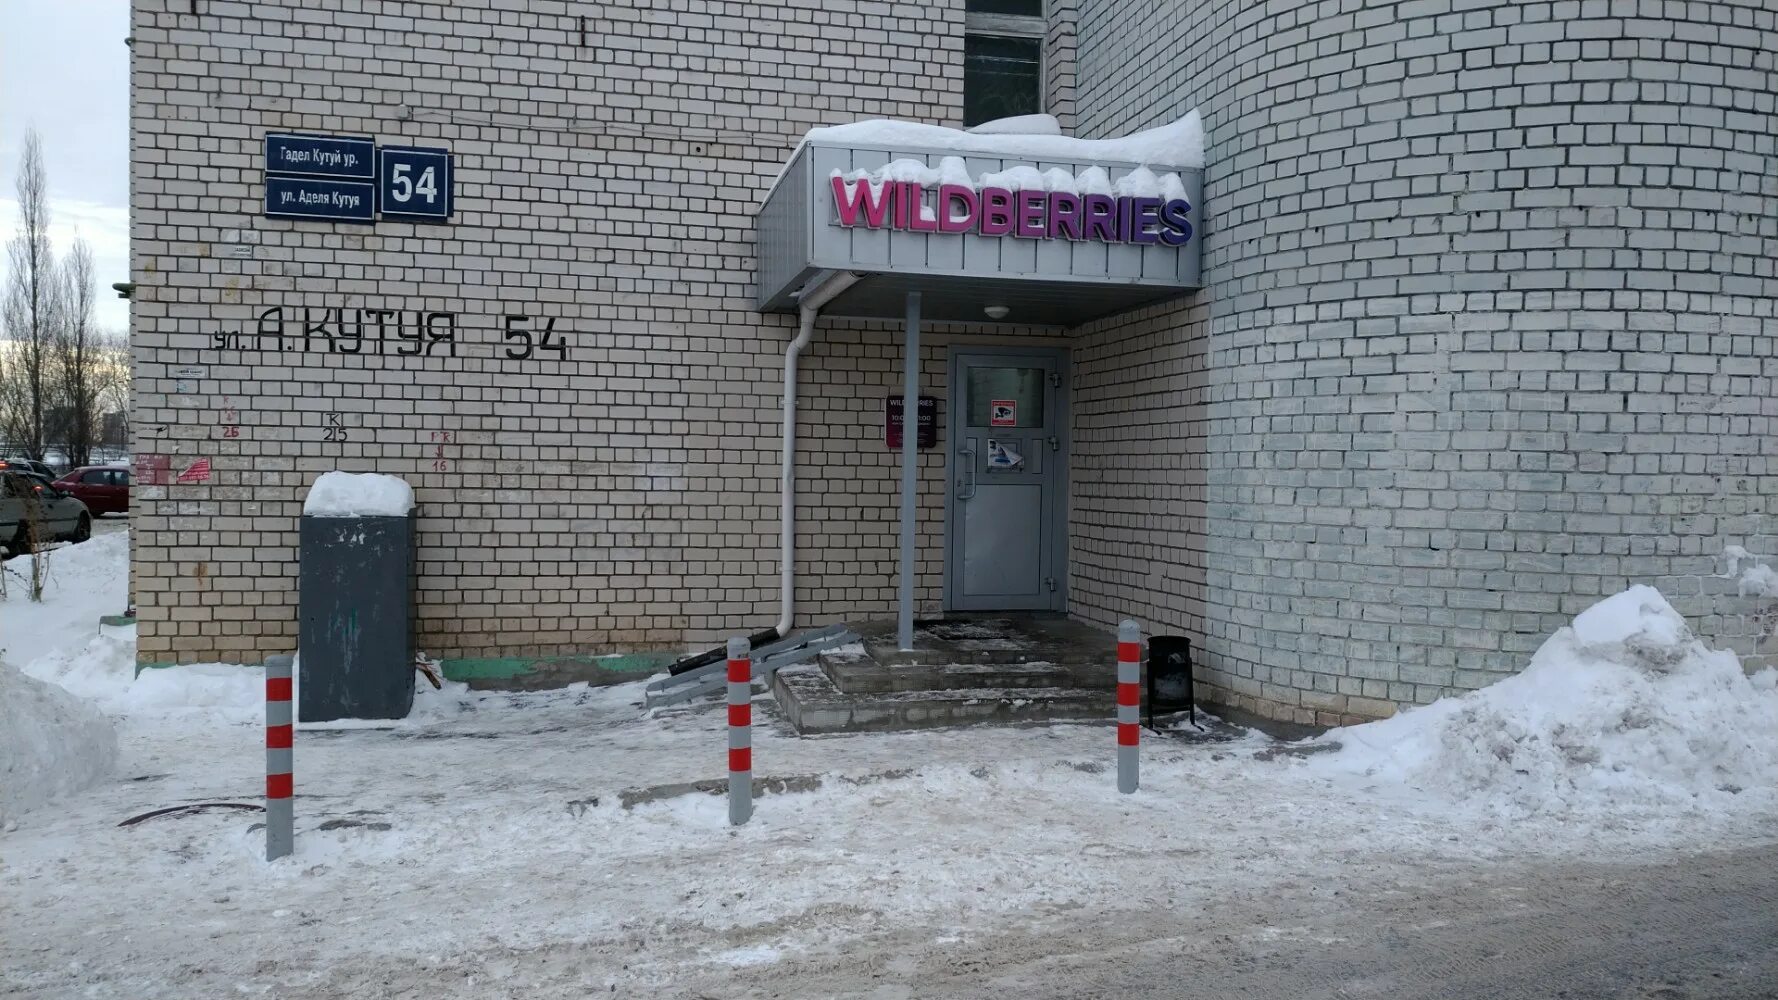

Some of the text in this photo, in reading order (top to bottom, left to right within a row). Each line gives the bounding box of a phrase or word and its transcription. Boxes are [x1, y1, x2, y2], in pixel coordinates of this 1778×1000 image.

[280, 146, 359, 168] Гадел Кутуй ур.
[391, 163, 438, 204] 54
[280, 189, 360, 208] ул. Аделя Кутуя
[830, 175, 1193, 247] WILDBERRIES
[214, 330, 246, 350] ул.
[505, 315, 566, 361] 54
[322, 427, 348, 442] 25
[431, 459, 447, 472] 16
